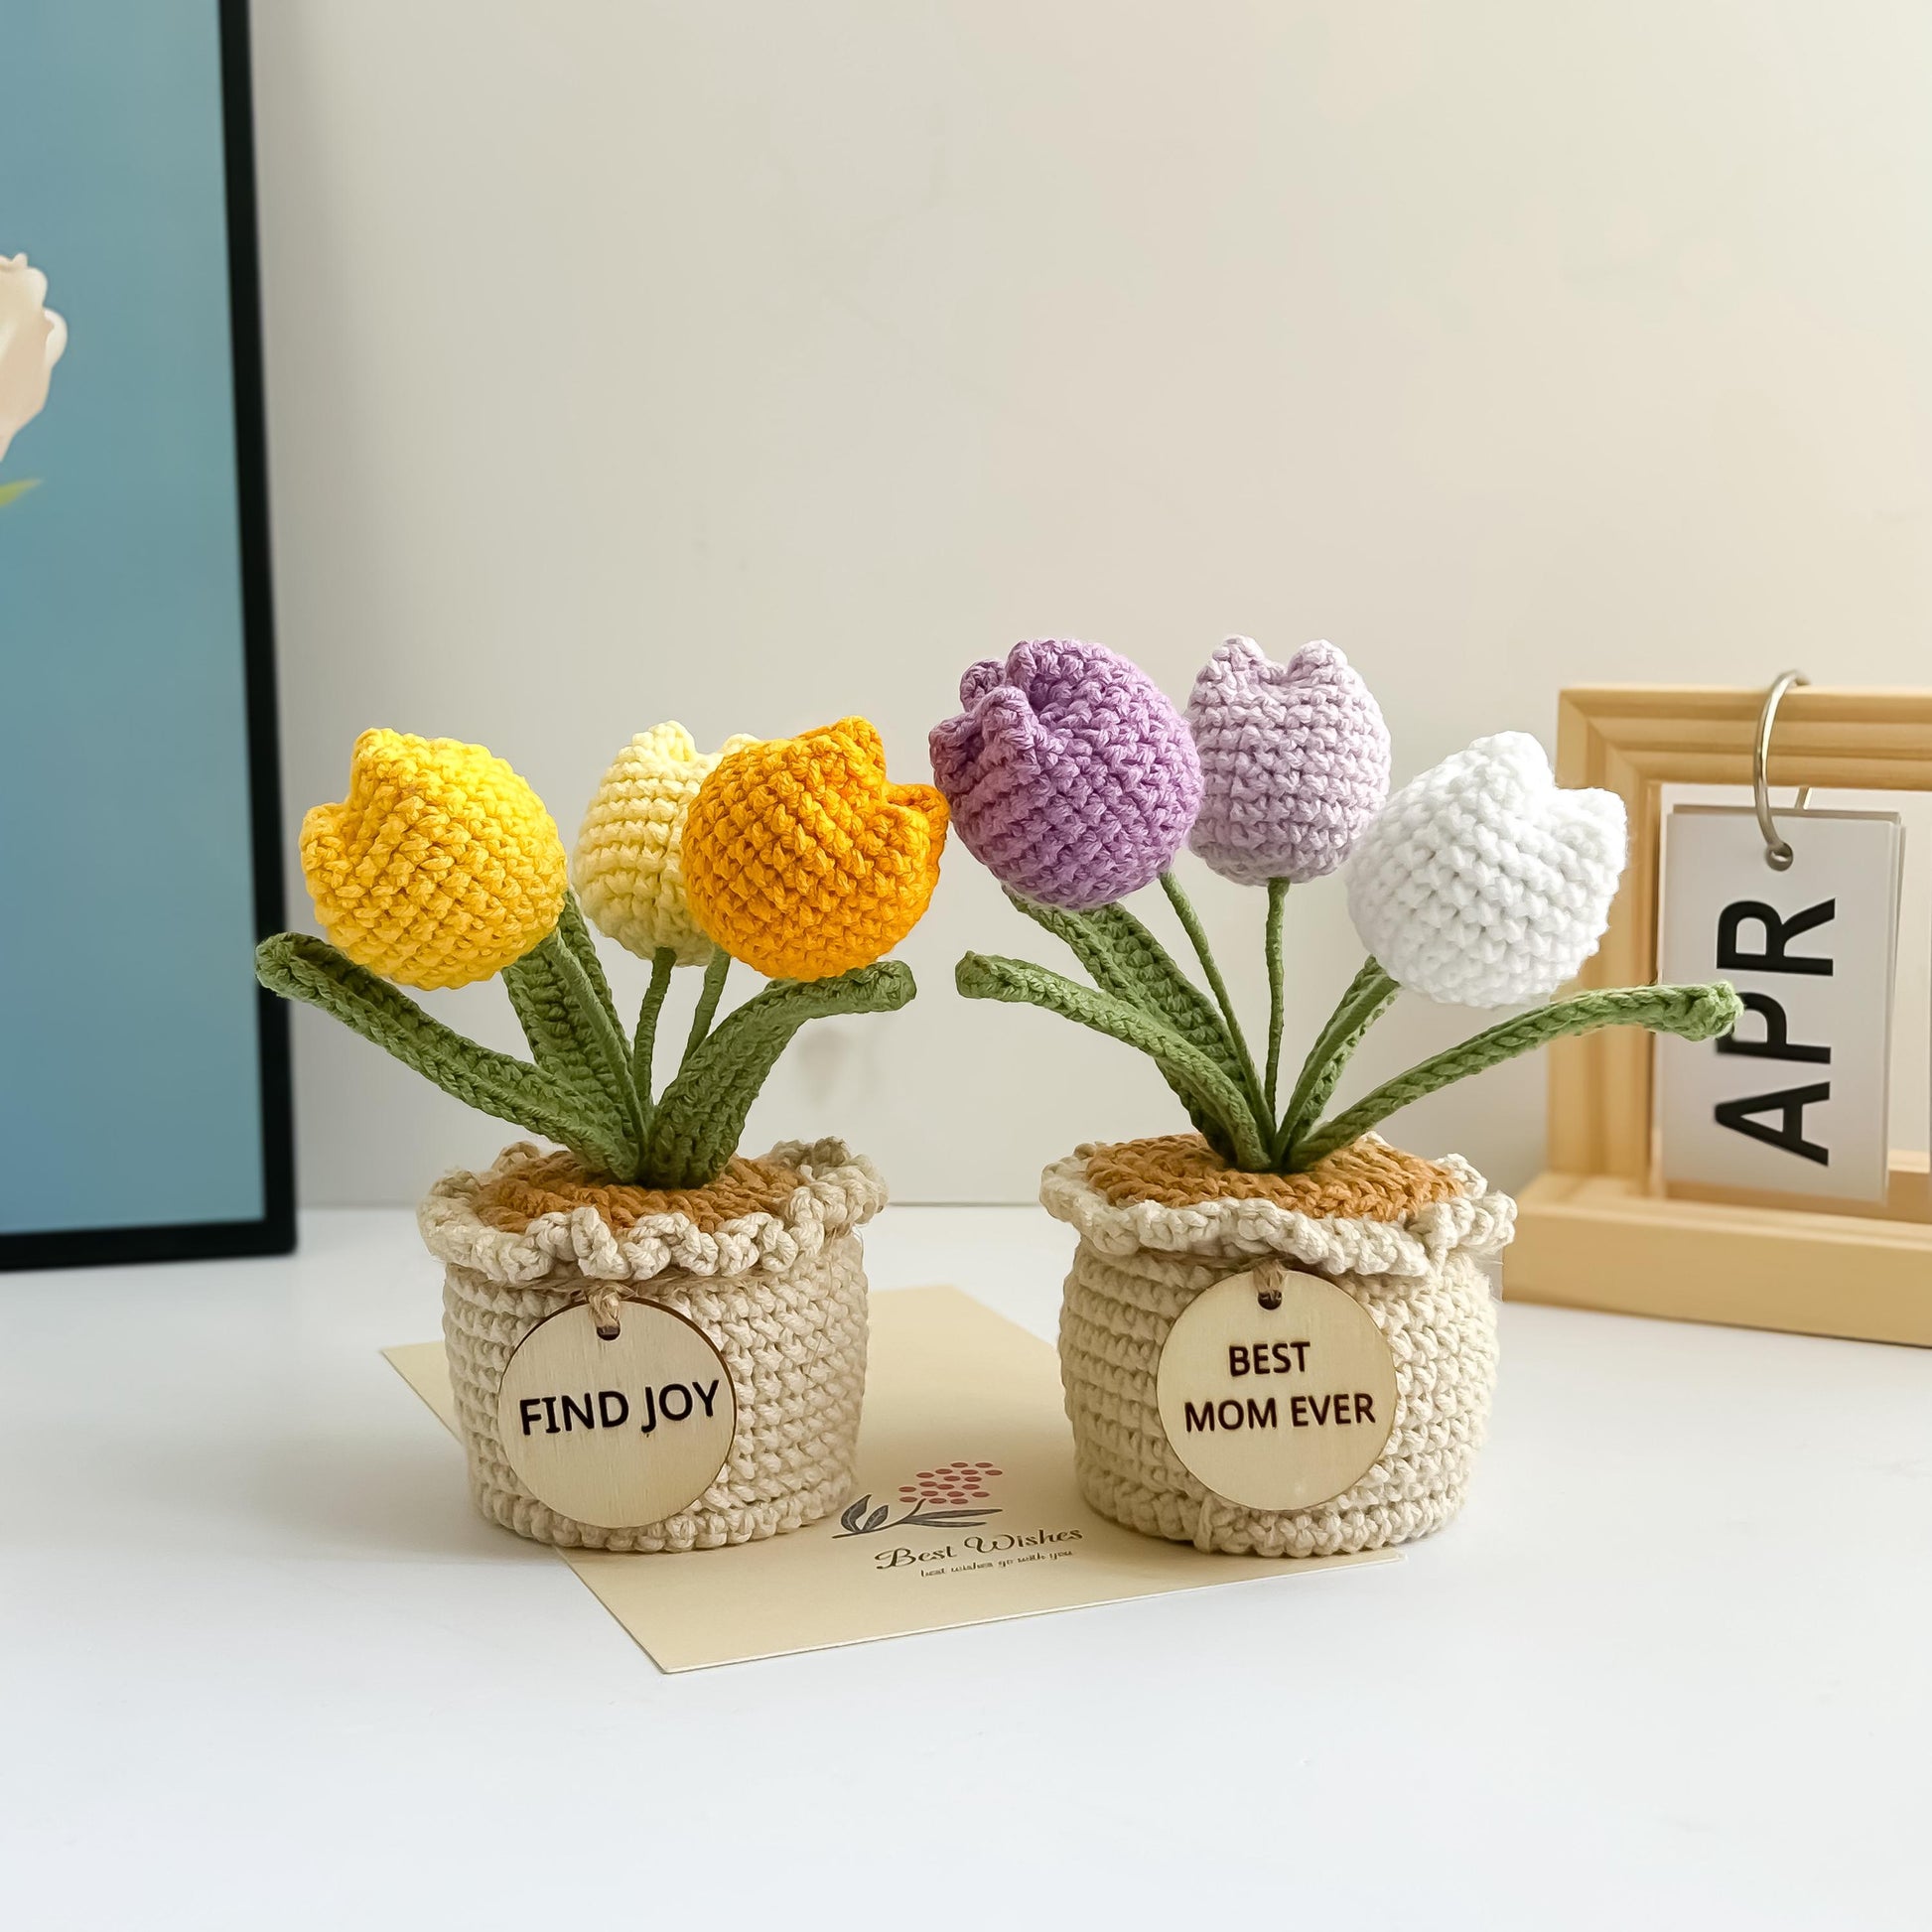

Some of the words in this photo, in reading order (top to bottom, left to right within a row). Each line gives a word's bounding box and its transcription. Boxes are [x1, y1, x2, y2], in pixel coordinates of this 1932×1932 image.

[1714, 897, 1836, 1166] APR
[1229, 1341, 1311, 1377] BEST
[519, 1390, 629, 1436] FIND
[641, 1379, 720, 1434] JOY
[1184, 1398, 1278, 1433] MOM
[1291, 1393, 1376, 1428] EVER
[874, 1545, 957, 1570] Best
[964, 1528, 1083, 1554] Wishes
[998, 1559, 1013, 1568] go
[1049, 1549, 1073, 1560] you
